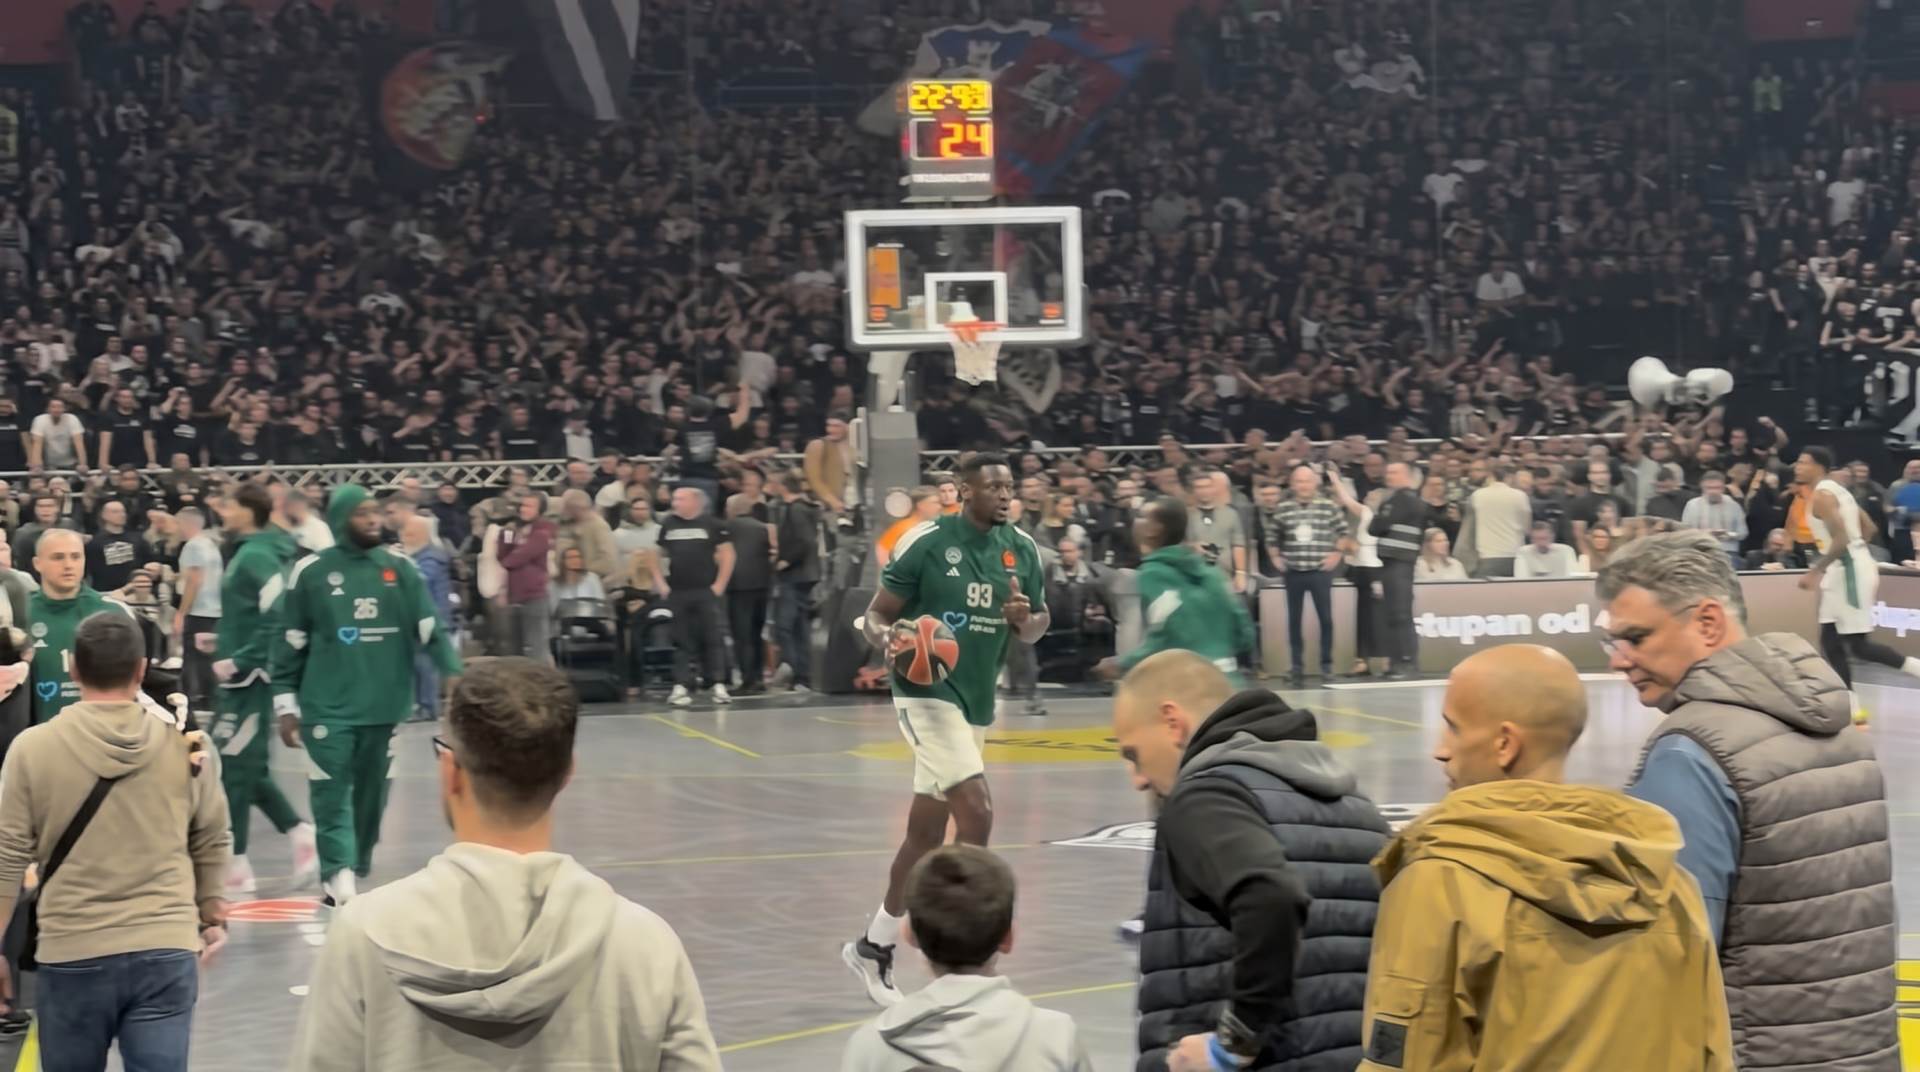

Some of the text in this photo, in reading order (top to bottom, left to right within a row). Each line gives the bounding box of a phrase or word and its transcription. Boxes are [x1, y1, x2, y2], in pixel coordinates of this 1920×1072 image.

[939, 122, 992, 159] 24
[354, 597, 378, 619] 26
[966, 582, 993, 608] 93
[1538, 603, 1590, 634] od
